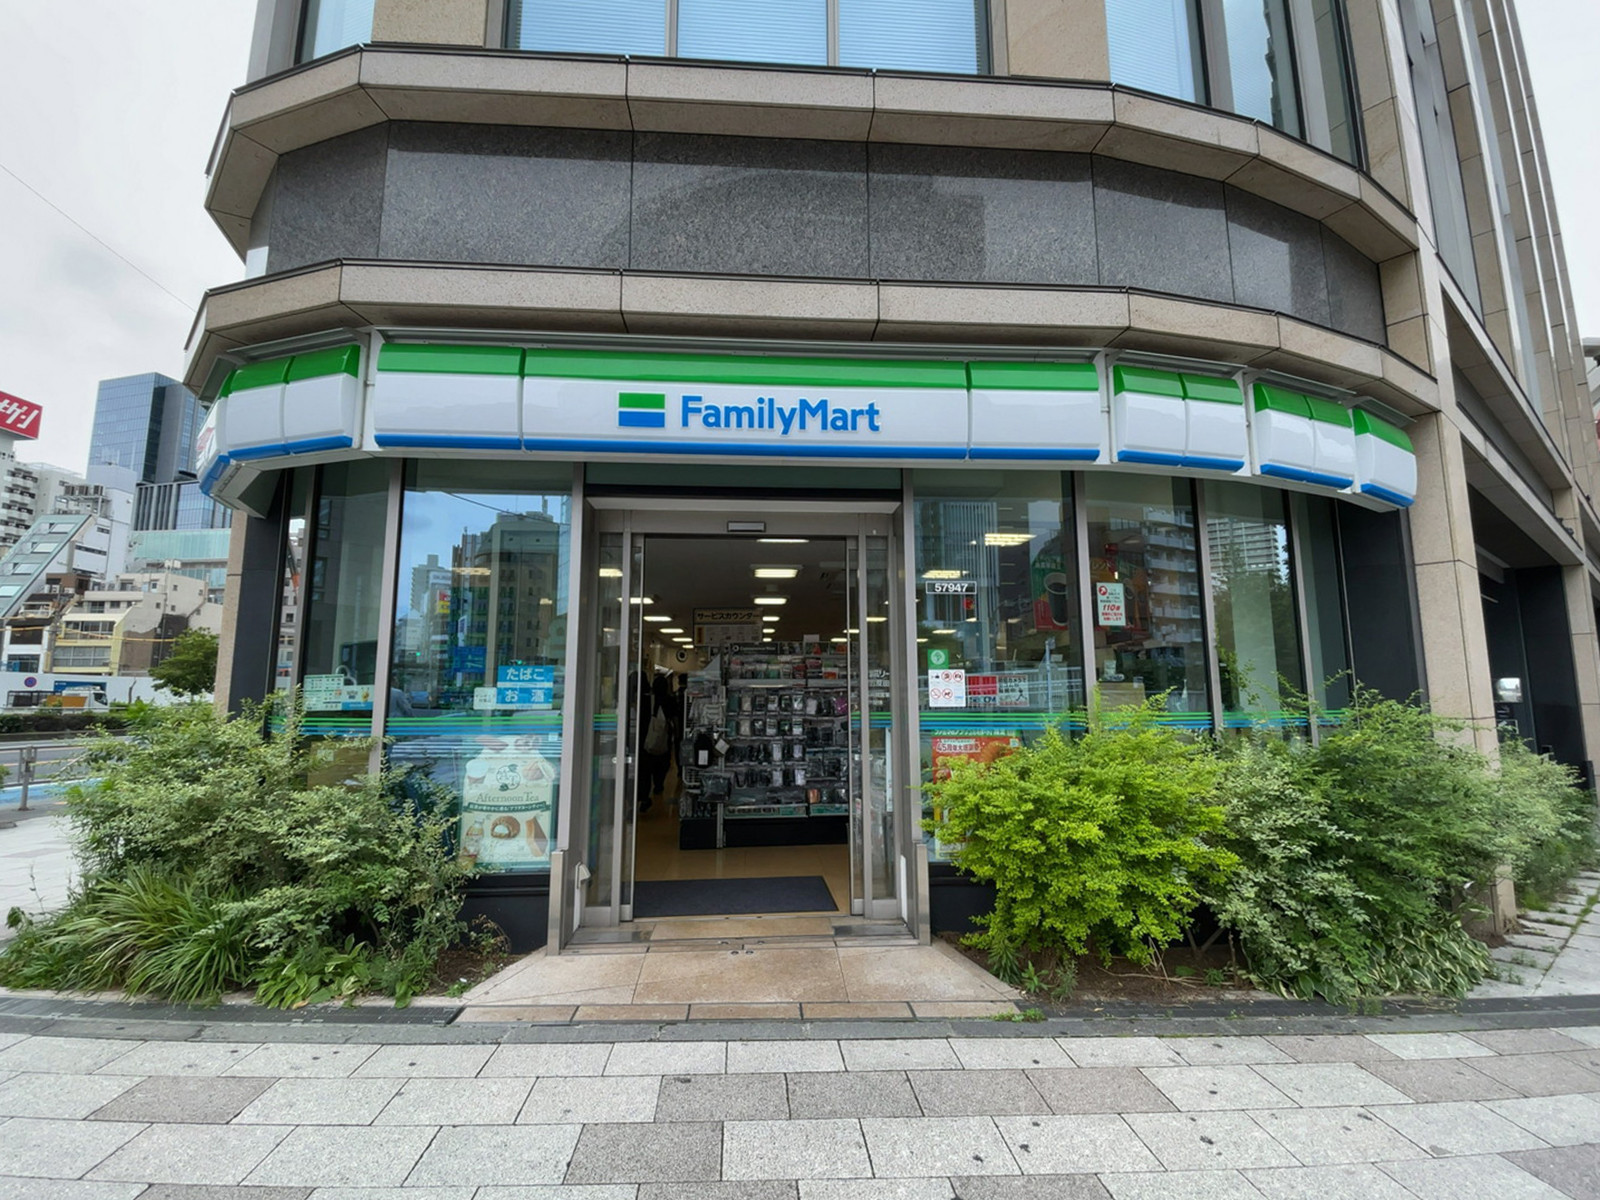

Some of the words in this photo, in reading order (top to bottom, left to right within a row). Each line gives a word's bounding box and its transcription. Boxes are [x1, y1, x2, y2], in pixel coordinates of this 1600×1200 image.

[681, 395, 880, 435] FamilyMart
[934, 583, 968, 592] 57947
[697, 612, 760, 620] サービスカウンター
[506, 667, 545, 680] たばこ
[476, 792, 522, 802] Afternoon
[523, 791, 540, 802] Tea
